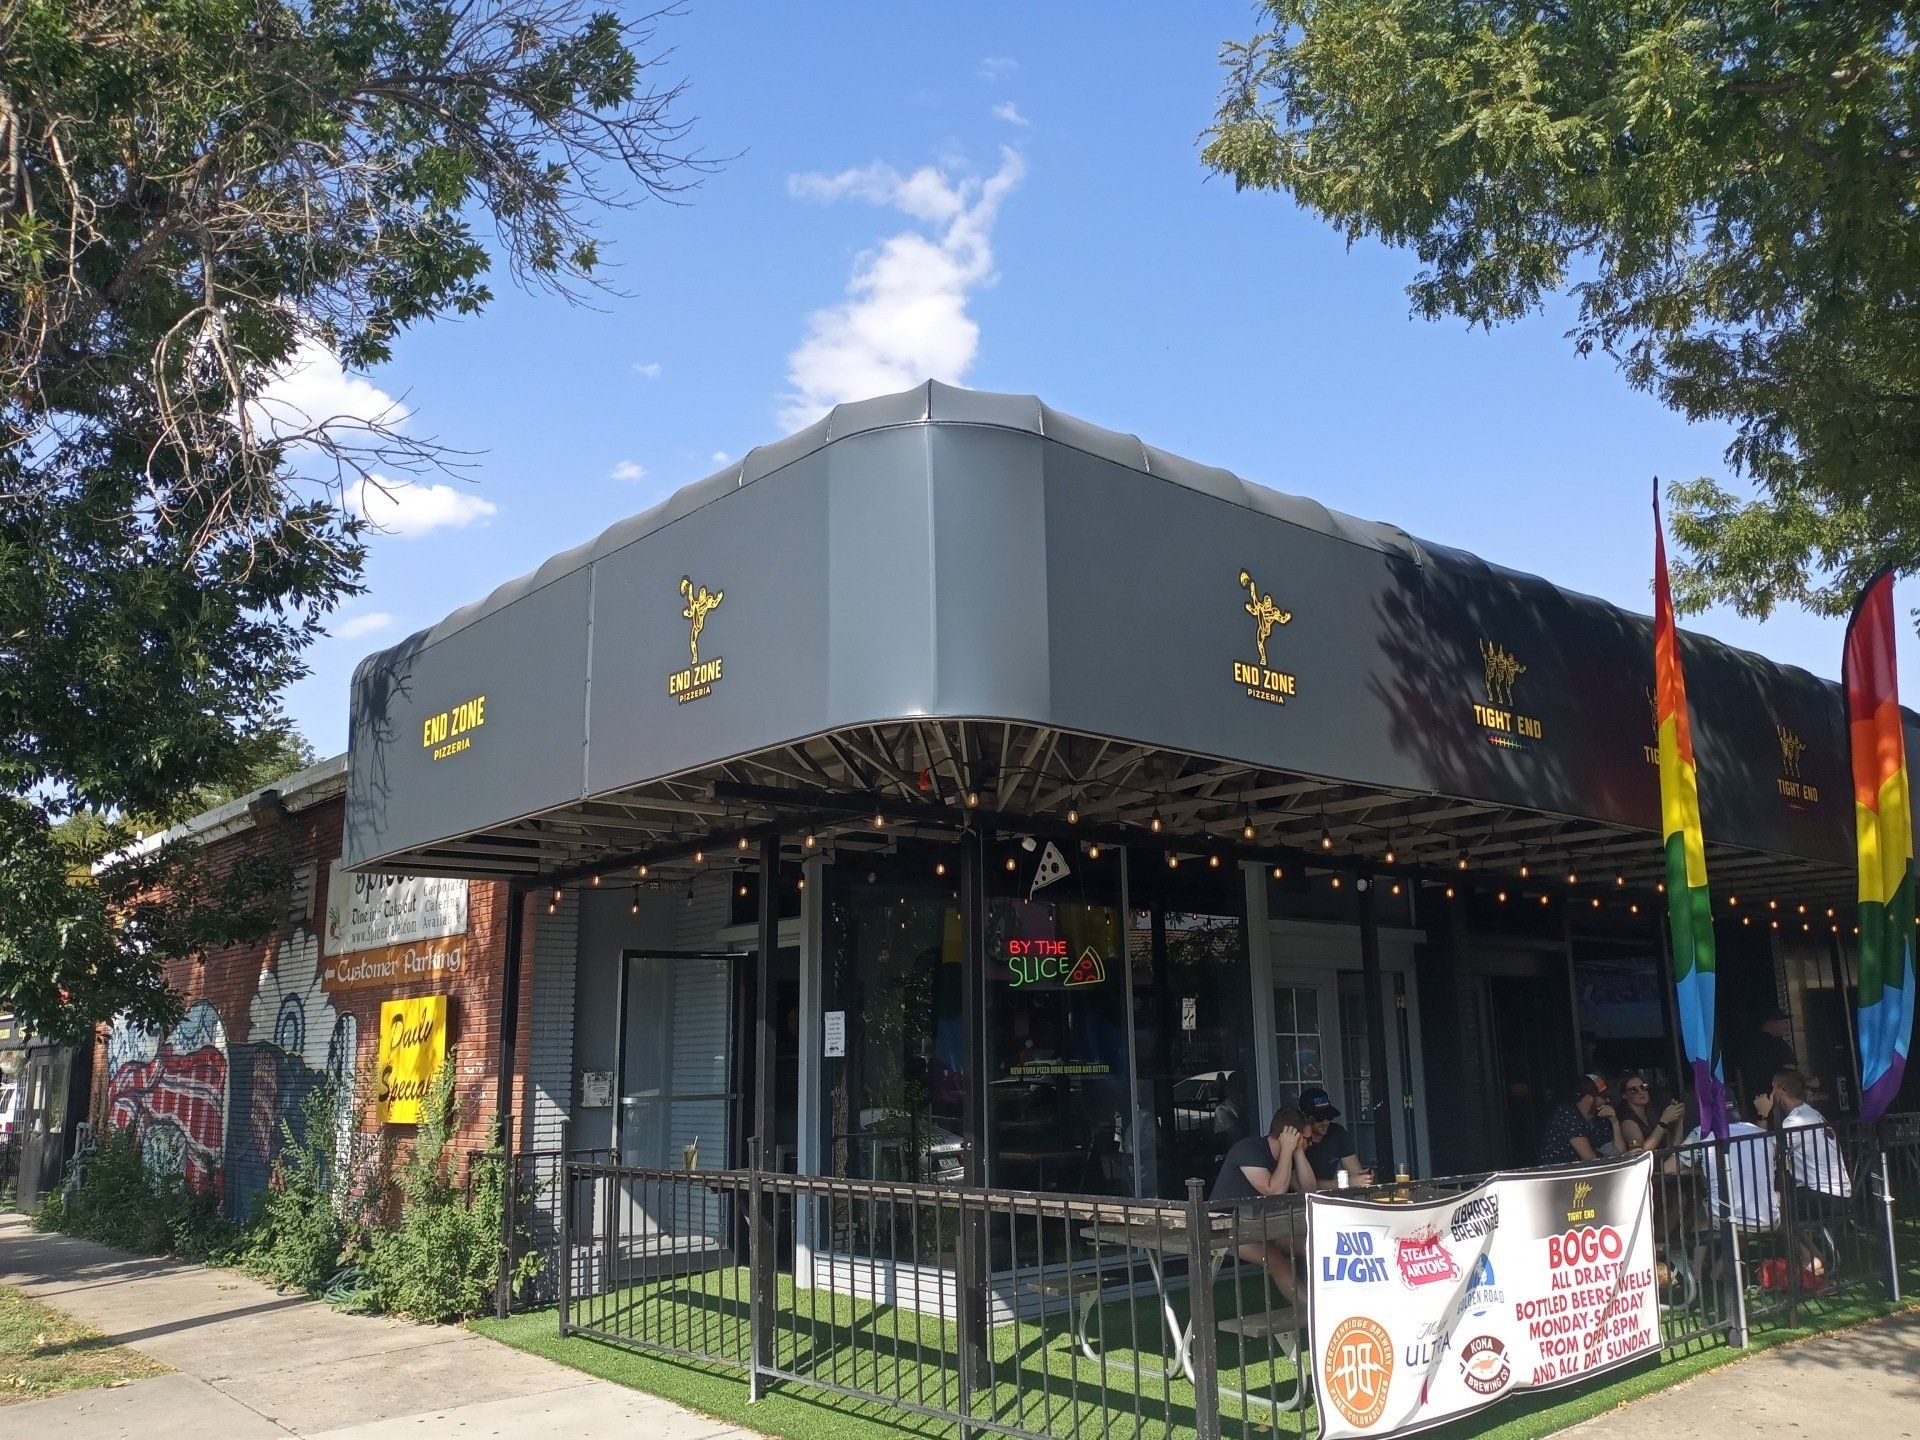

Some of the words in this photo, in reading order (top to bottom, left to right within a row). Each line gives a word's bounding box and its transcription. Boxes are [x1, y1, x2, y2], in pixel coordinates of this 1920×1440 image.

[669, 670, 691, 694] END
[693, 659, 722, 687] ZONE
[1234, 662, 1260, 686] END
[1263, 669, 1295, 696] ZONE
[679, 686, 711, 703] PIZZERIA
[1247, 689, 1284, 704] PIZZERIA
[423, 713, 447, 747] END
[450, 696, 485, 737] ZONE
[1473, 704, 1512, 731] TIGHT
[1517, 716, 1542, 739] END
[433, 737, 470, 760] PIZZERIA
[1643, 745, 1660, 764] TIG
[1777, 778, 1800, 798] TIGHT
[1803, 785, 1819, 802] END
[423, 911, 460, 929] Availabe
[1009, 940, 1031, 954] BY
[1035, 940, 1067, 954] THE
[337, 957, 398, 982] Customer
[404, 945, 461, 974] Parking
[1009, 957, 1070, 987] SLICE
[1010, 1066, 1022, 1075] NEW
[1023, 1066, 1036, 1075] YORK
[1037, 1066, 1050, 1074] PIZZA
[1092, 1064, 1110, 1073] BETTER
[1567, 1211, 1582, 1222] TIGHT
[1584, 1209, 1595, 1219] END
[1336, 1231, 1374, 1256] BUD
[1400, 1244, 1442, 1263] STELLA
[1549, 1227, 1622, 1269] BOGO
[1323, 1257, 1389, 1282] LIGHT
[1406, 1258, 1450, 1277] ARTOIS
[1551, 1272, 1572, 1291] ALL
[1484, 1289, 1504, 1304] ROAD
[1515, 1295, 1568, 1321] BOTTLED
[1618, 1268, 1651, 1293] WELLS
[1529, 1291, 1644, 1340] MONDAY-SAURDAY
[1370, 1323, 1392, 1367] BREWERY
[1406, 1331, 1451, 1367] ULTRA
[1470, 1337, 1494, 1354] KONA
[1532, 1363, 1556, 1386] AND
[1560, 1356, 1579, 1375] ALL
[1583, 1345, 1603, 1370] DAY
[1607, 1328, 1651, 1360] SUNDAY
[1540, 1336, 1578, 1359] FROM
[1467, 1375, 1502, 1392] BREWING
[1330, 1387, 1347, 1412] FINE
[1347, 1406, 1381, 1425] COLORADO
